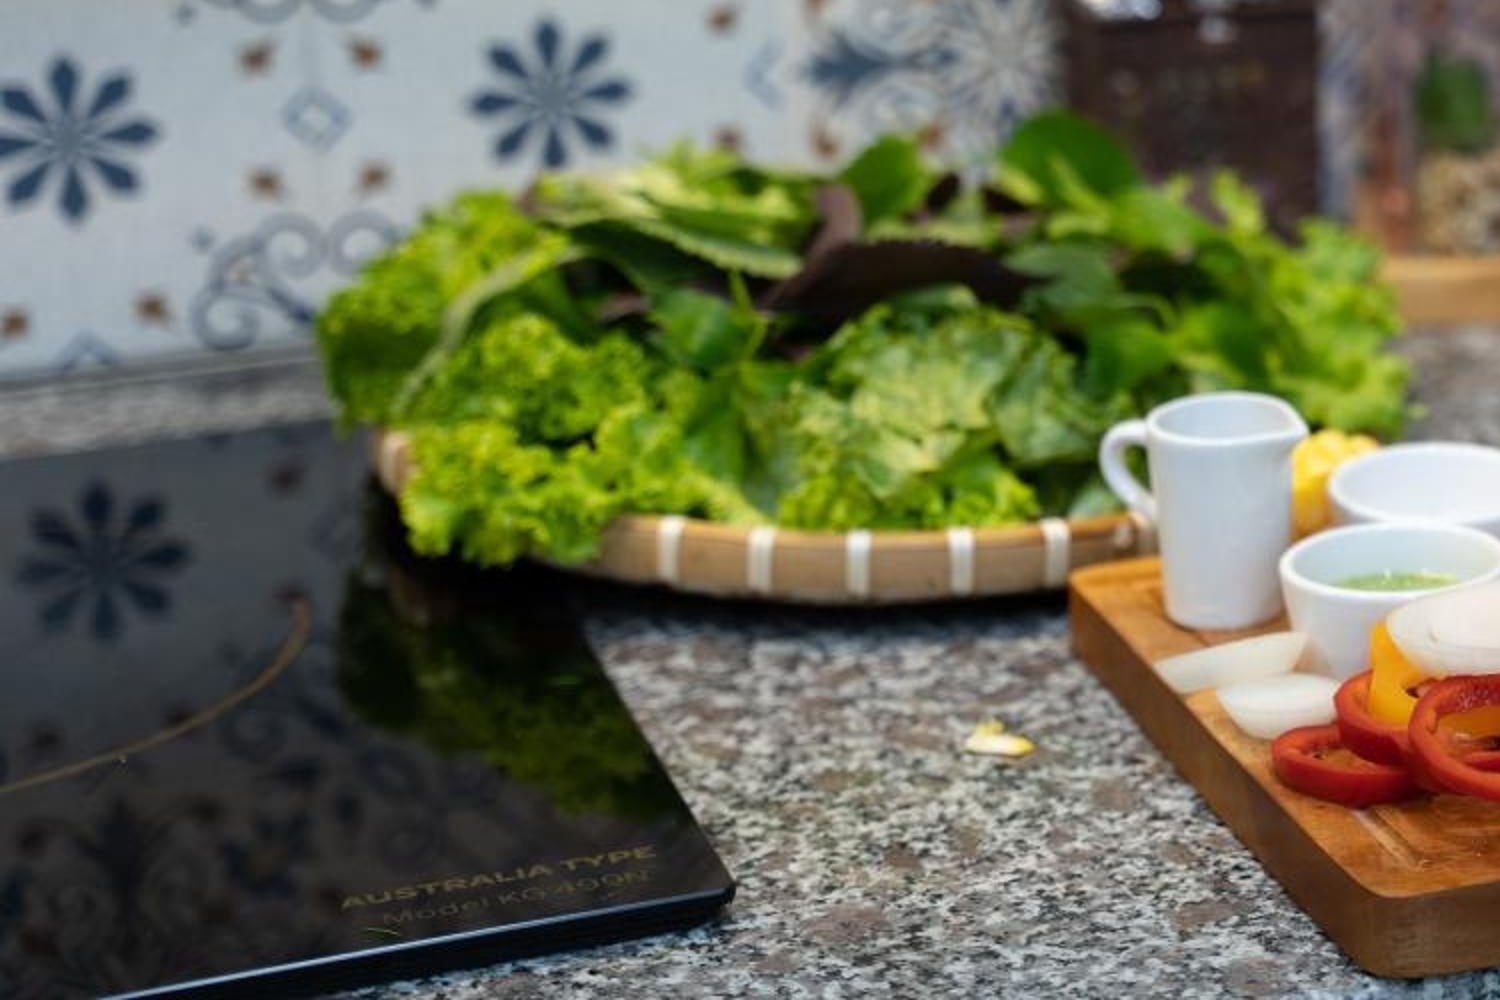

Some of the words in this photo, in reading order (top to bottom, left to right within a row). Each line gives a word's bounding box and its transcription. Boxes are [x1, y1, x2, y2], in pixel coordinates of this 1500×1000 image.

[341, 864, 553, 909] AUSTRALIA
[560, 844, 656, 870] TYPE
[383, 897, 489, 924] Model
